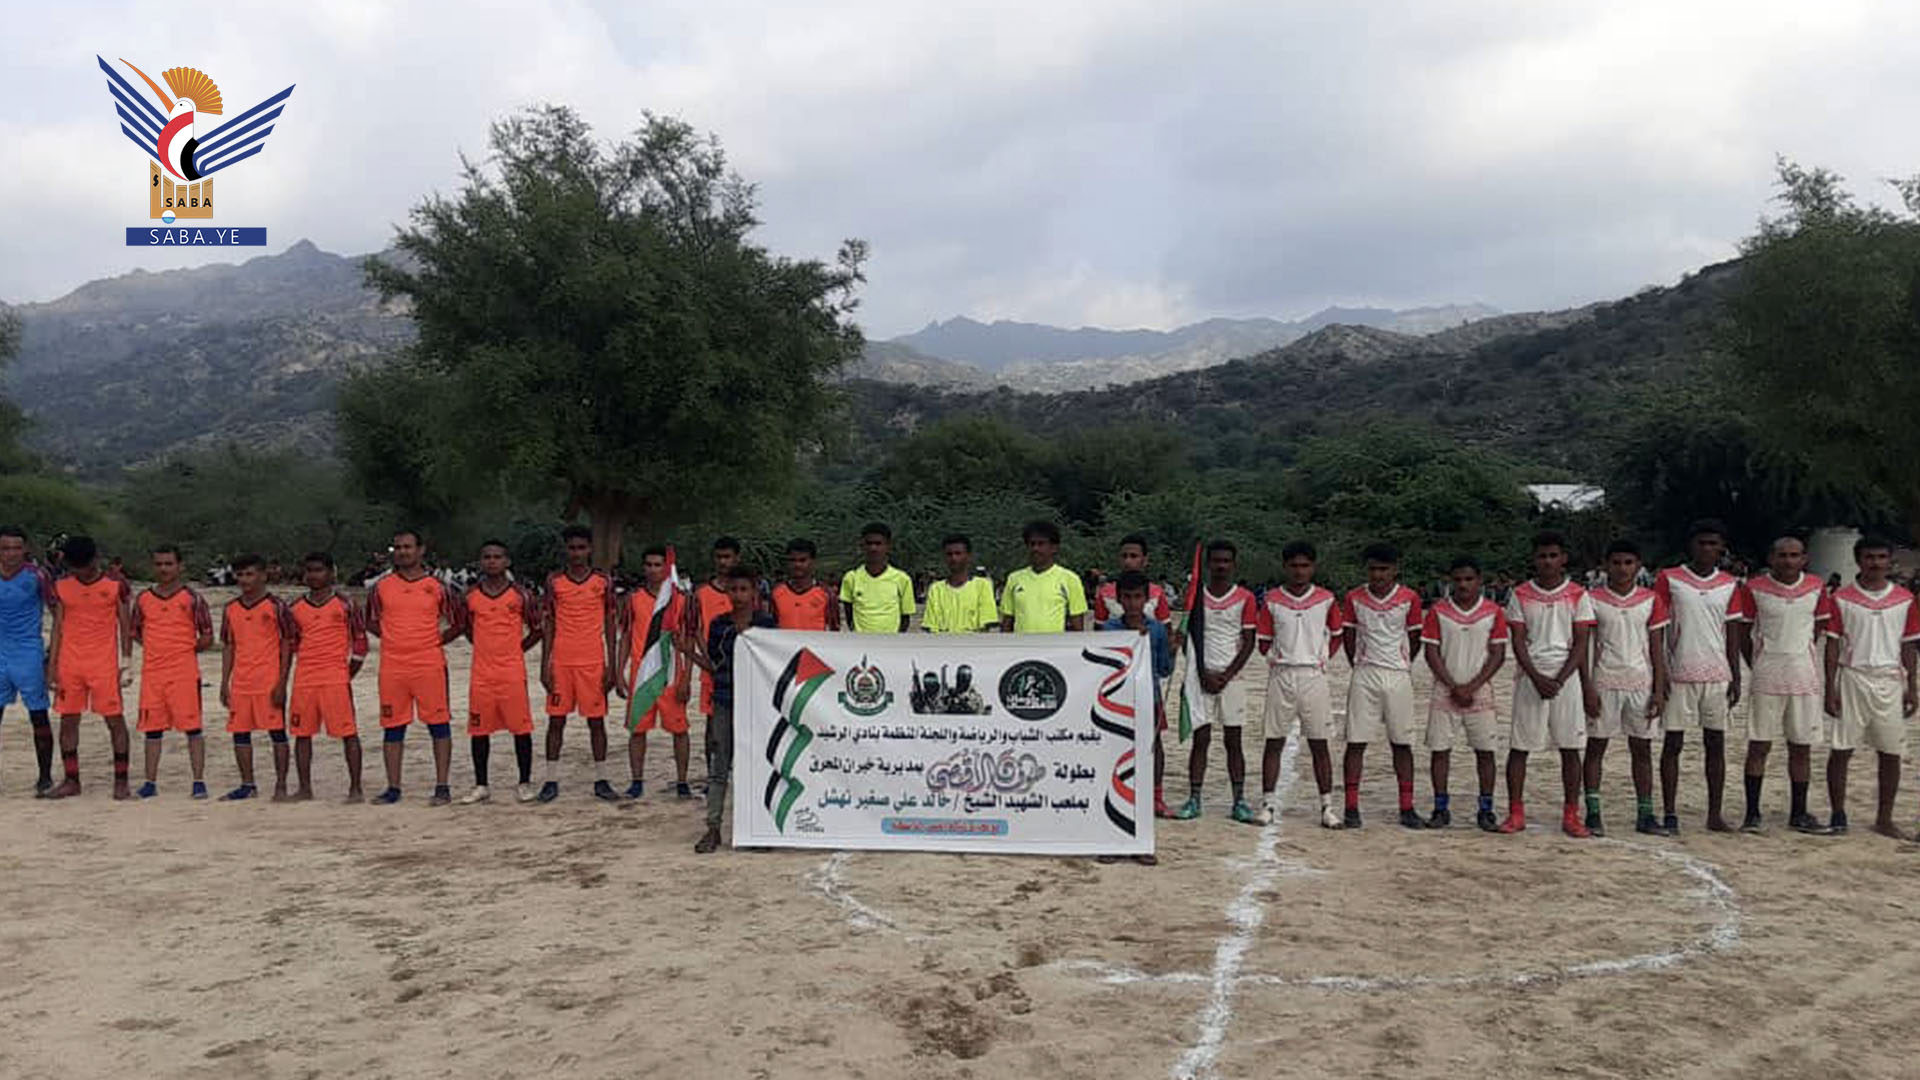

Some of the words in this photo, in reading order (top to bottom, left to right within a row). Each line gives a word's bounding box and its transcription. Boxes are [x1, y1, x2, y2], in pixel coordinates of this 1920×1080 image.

[816, 725, 852, 742] الرشيد
[852, 726, 880, 745] بنادي
[882, 725, 920, 740] المنظمة
[920, 726, 957, 744] واللجنة
[958, 726, 1007, 746] والرياضة
[1008, 728, 1044, 746] الشباب
[1045, 727, 1074, 746] مكتب
[878, 756, 924, 776] بمديرية
[1052, 761, 1097, 784] بطولة
[817, 788, 852, 809] نهشل
[855, 790, 890, 810] صغير
[922, 791, 951, 808] خالد
[963, 792, 1002, 814] الشيخ
[1004, 792, 1048, 813] الشهيد
[1051, 794, 1090, 814] بملعب
